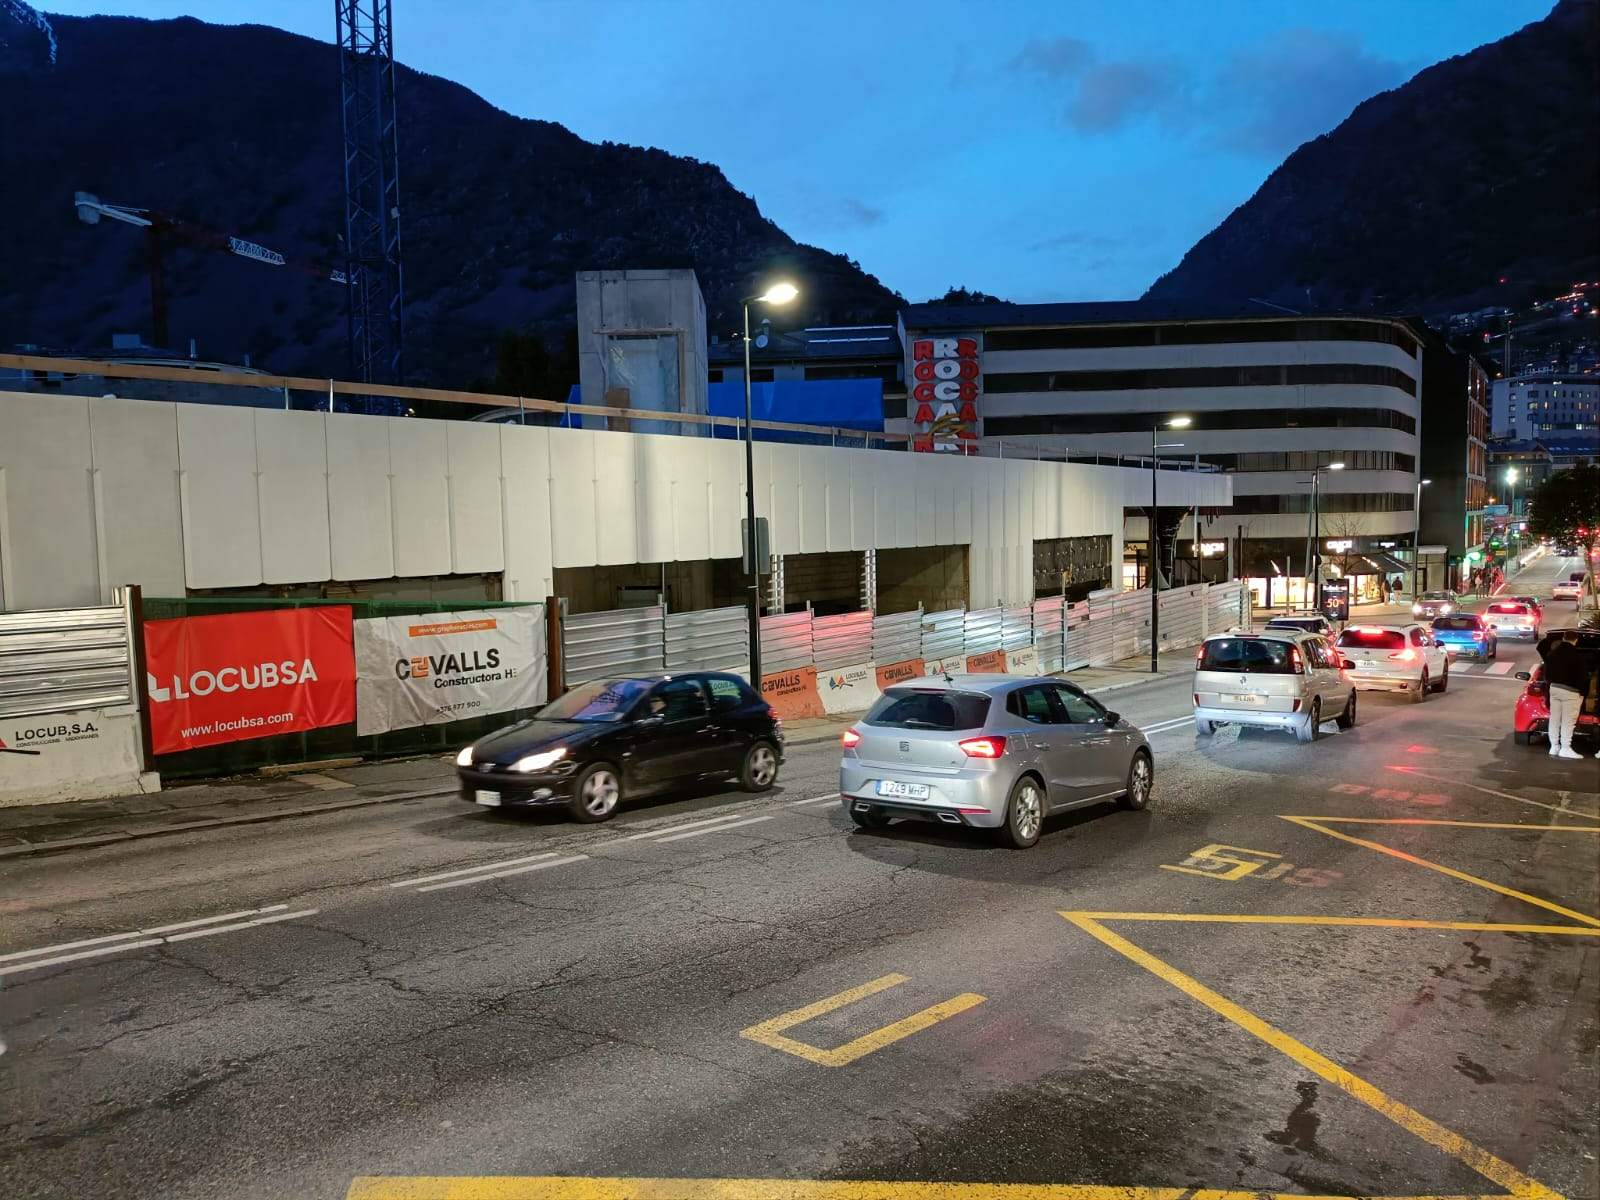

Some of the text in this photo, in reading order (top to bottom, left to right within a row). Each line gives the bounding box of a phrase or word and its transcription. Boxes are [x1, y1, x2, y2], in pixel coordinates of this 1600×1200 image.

[173, 658, 318, 700] LOCUBSA
[434, 672, 501, 688] Constructora
[181, 711, 294, 738] www.locubsa.com
